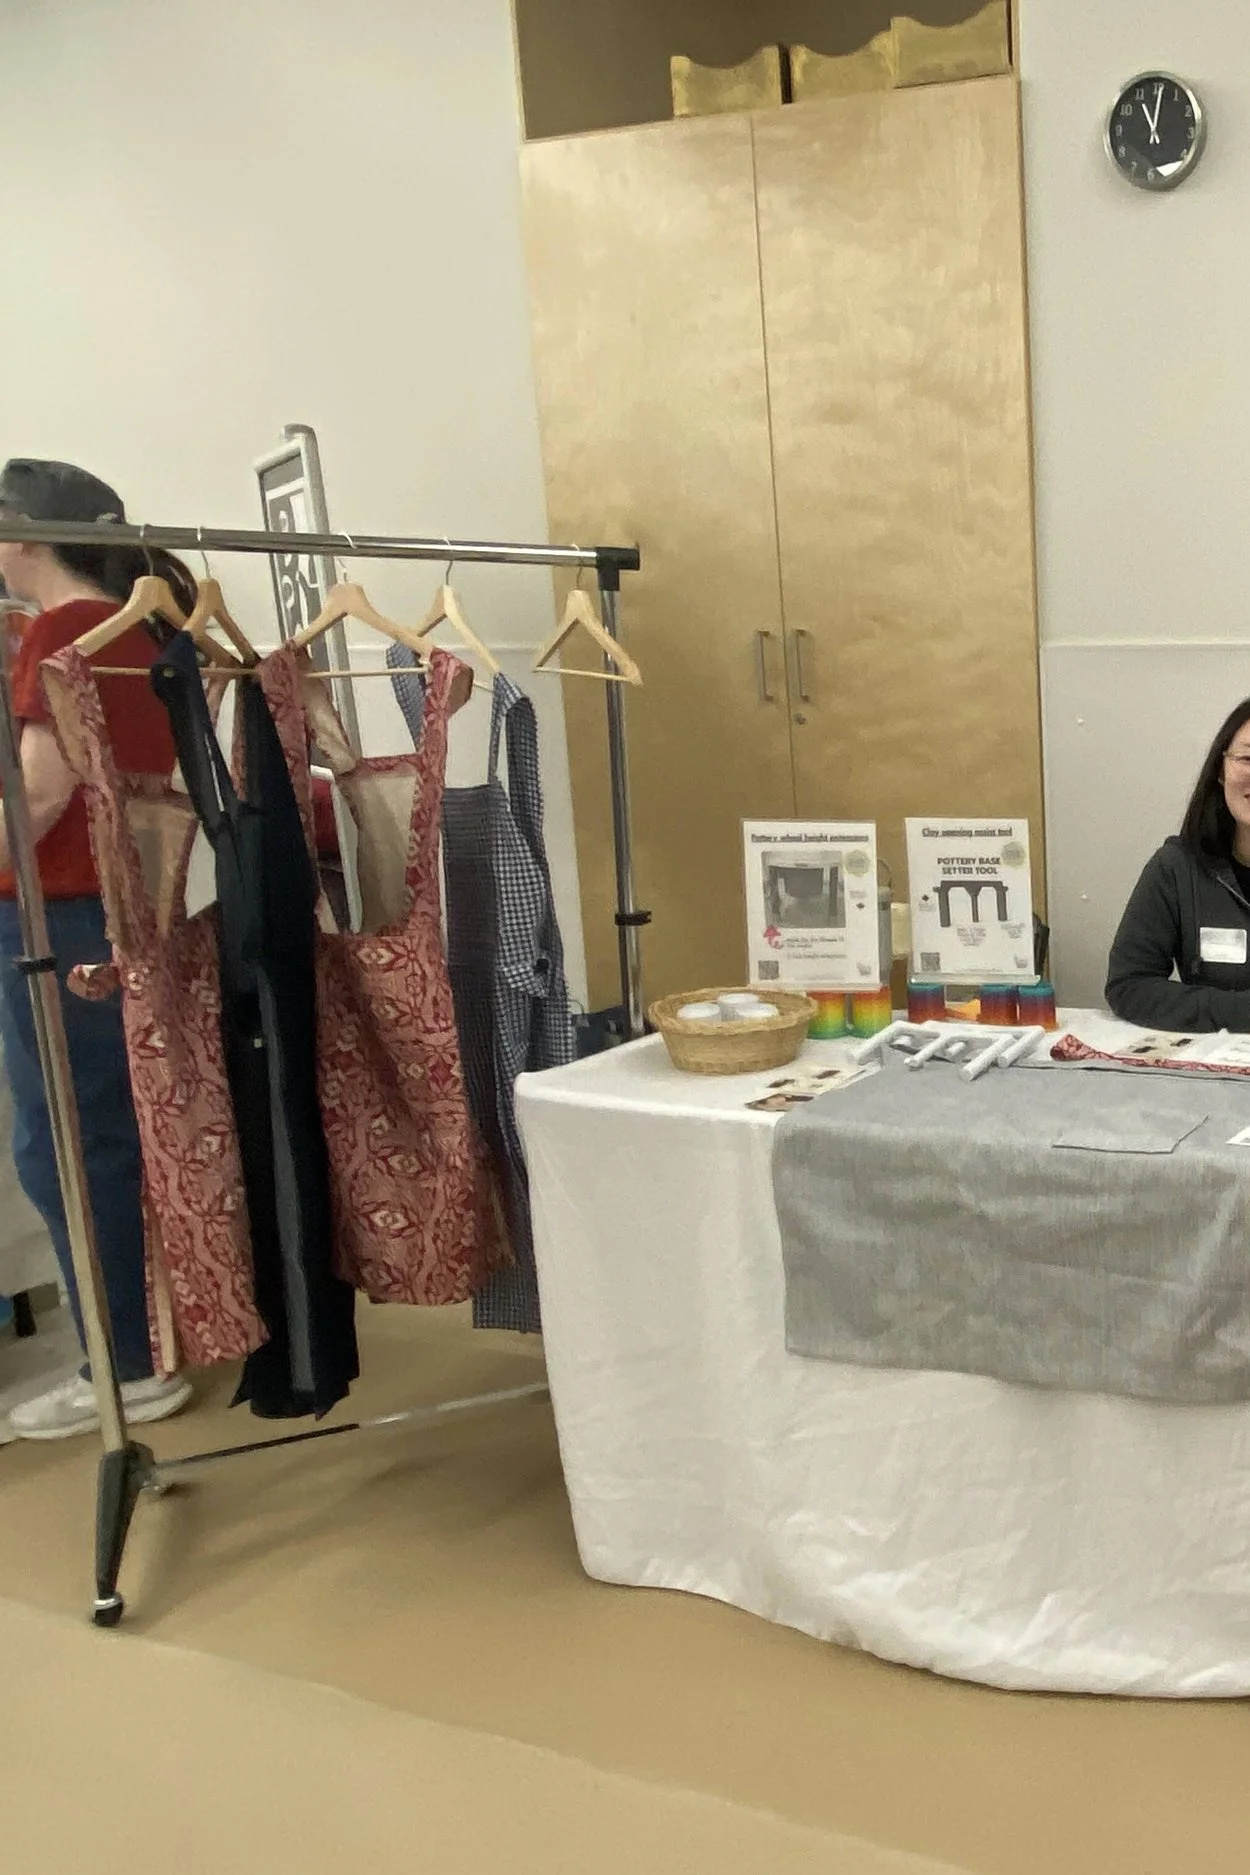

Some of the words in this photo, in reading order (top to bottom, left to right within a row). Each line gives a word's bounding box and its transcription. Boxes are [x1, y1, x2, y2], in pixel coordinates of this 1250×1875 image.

[1135, 88, 1144, 100] 11
[1173, 89, 1179, 101] 1
[1120, 104, 1132, 115] 10
[1184, 105, 1192, 117] 2
[1115, 125, 1123, 136] 9
[1187, 128, 1194, 139] 3
[1118, 146, 1126, 157] 8
[1147, 169, 1155, 180] 6
[937, 857, 976, 865] POTTERY
[979, 857, 1000, 865] BASE
[942, 867, 973, 875] SETTER
[975, 867, 998, 875] TOOL
